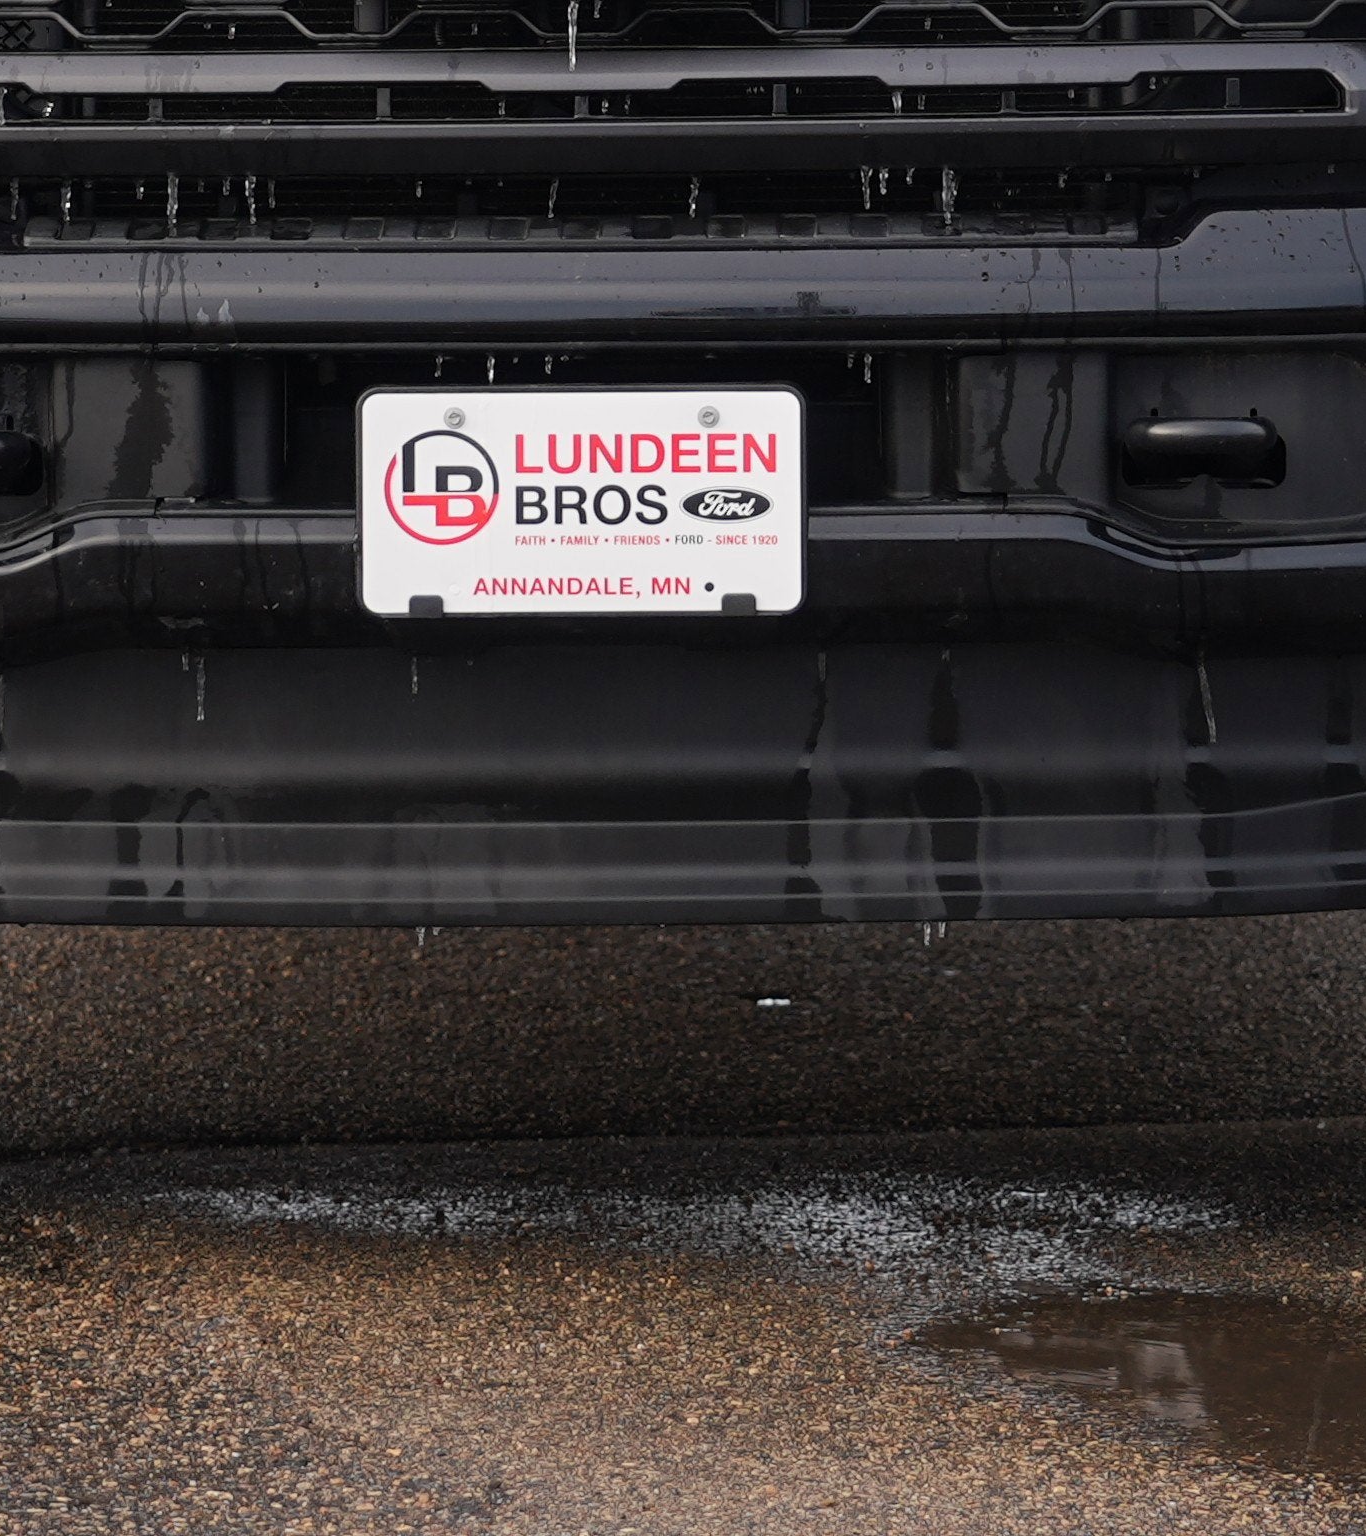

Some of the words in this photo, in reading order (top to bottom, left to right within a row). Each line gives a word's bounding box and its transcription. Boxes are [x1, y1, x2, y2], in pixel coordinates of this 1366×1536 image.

[514, 433, 778, 474] LUNDEEN
[514, 484, 669, 526] BROS
[697, 490, 756, 518] Ford
[514, 534, 547, 546] FAITH
[560, 534, 600, 546] FAMILY
[613, 534, 661, 546] FRIENDS
[674, 534, 704, 546] FORD
[715, 534, 748, 546] SINCE
[752, 534, 778, 546] 1920
[473, 576, 643, 599] ANNANDALE,
[650, 576, 692, 596] MN
